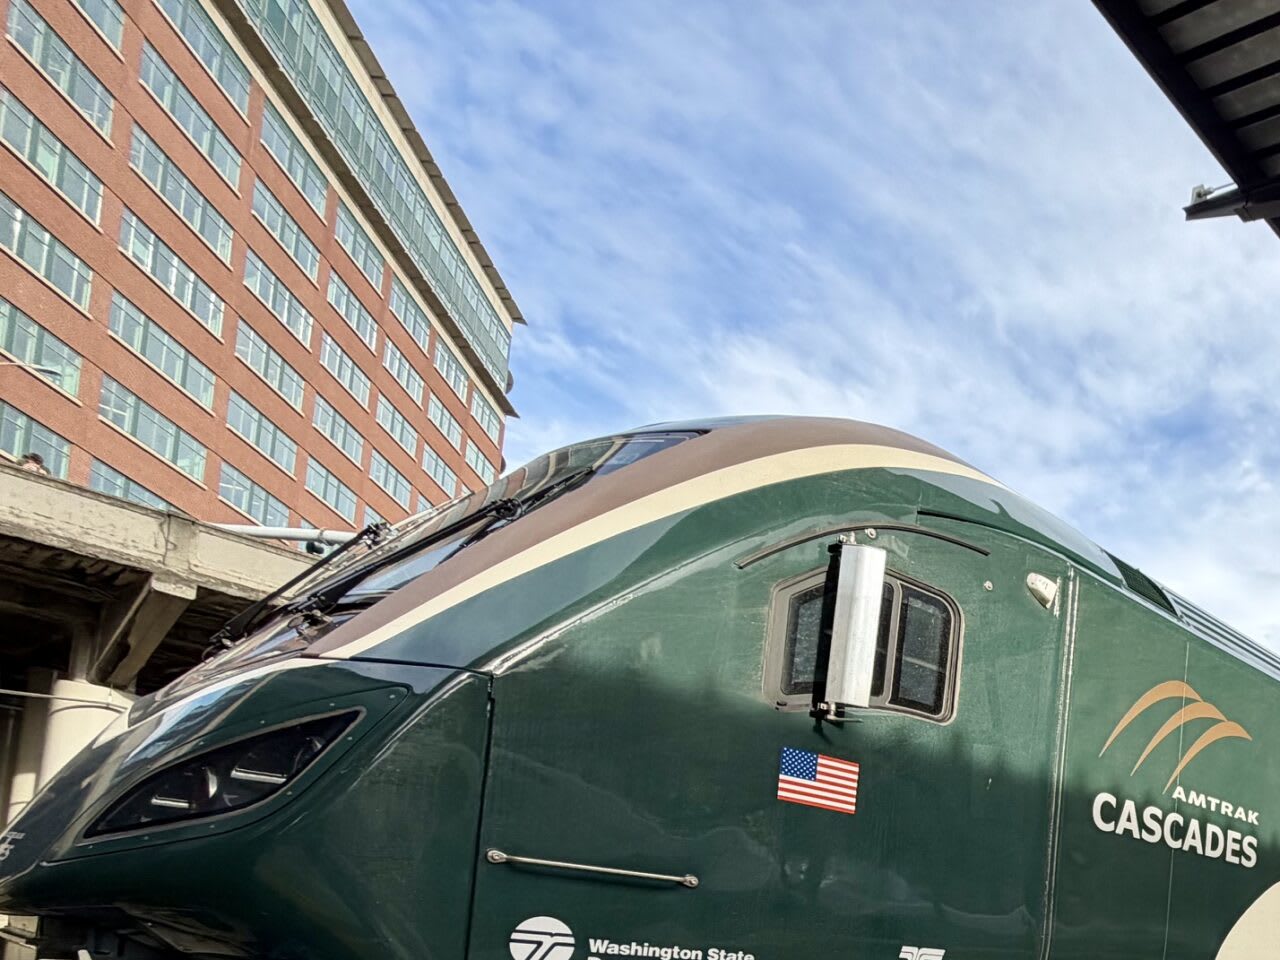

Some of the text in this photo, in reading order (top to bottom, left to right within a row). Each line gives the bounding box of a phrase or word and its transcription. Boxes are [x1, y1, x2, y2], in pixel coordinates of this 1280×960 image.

[1172, 785, 1259, 825] AMTRAK
[1092, 792, 1258, 868] CASCADES
[588, 938, 703, 960] Washington
